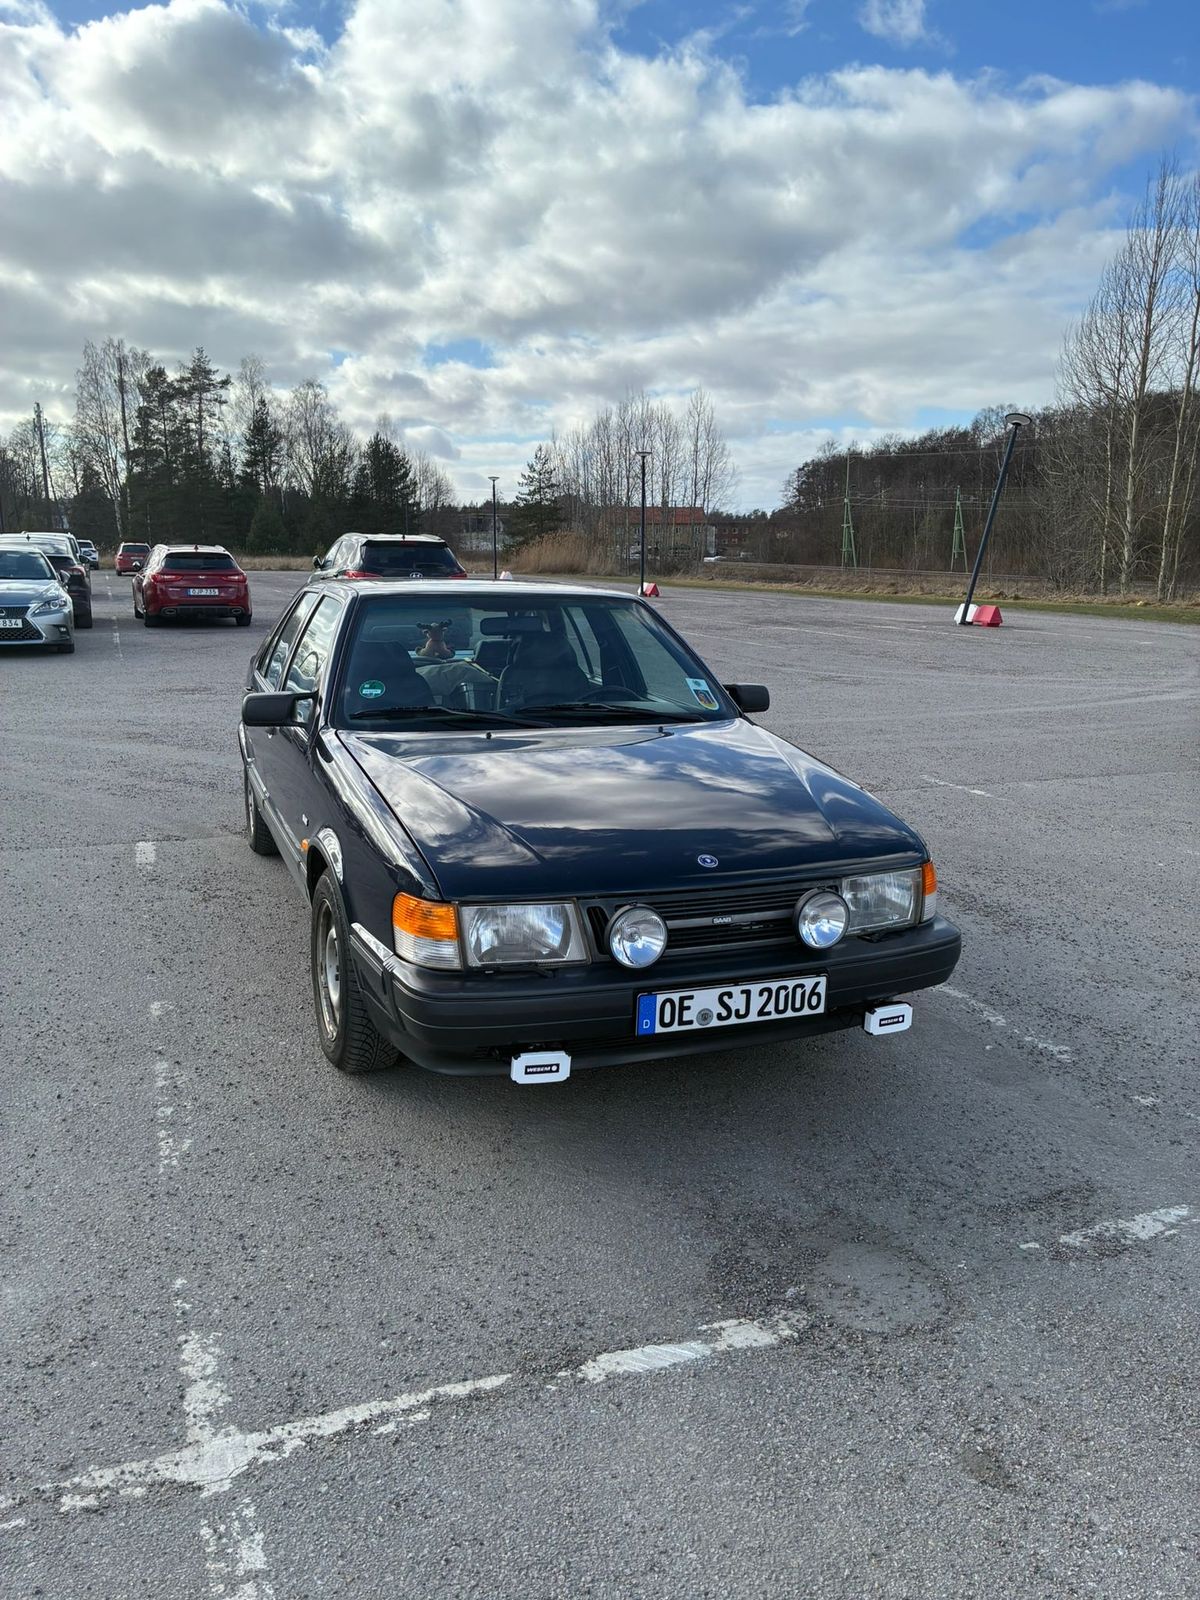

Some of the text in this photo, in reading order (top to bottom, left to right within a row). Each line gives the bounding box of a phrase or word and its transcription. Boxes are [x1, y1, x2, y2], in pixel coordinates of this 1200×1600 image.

[2, 619, 19, 627] 834
[713, 916, 732, 924] SAAB
[658, 980, 822, 1029] OE SJ 2006
[642, 1019, 651, 1029] D
